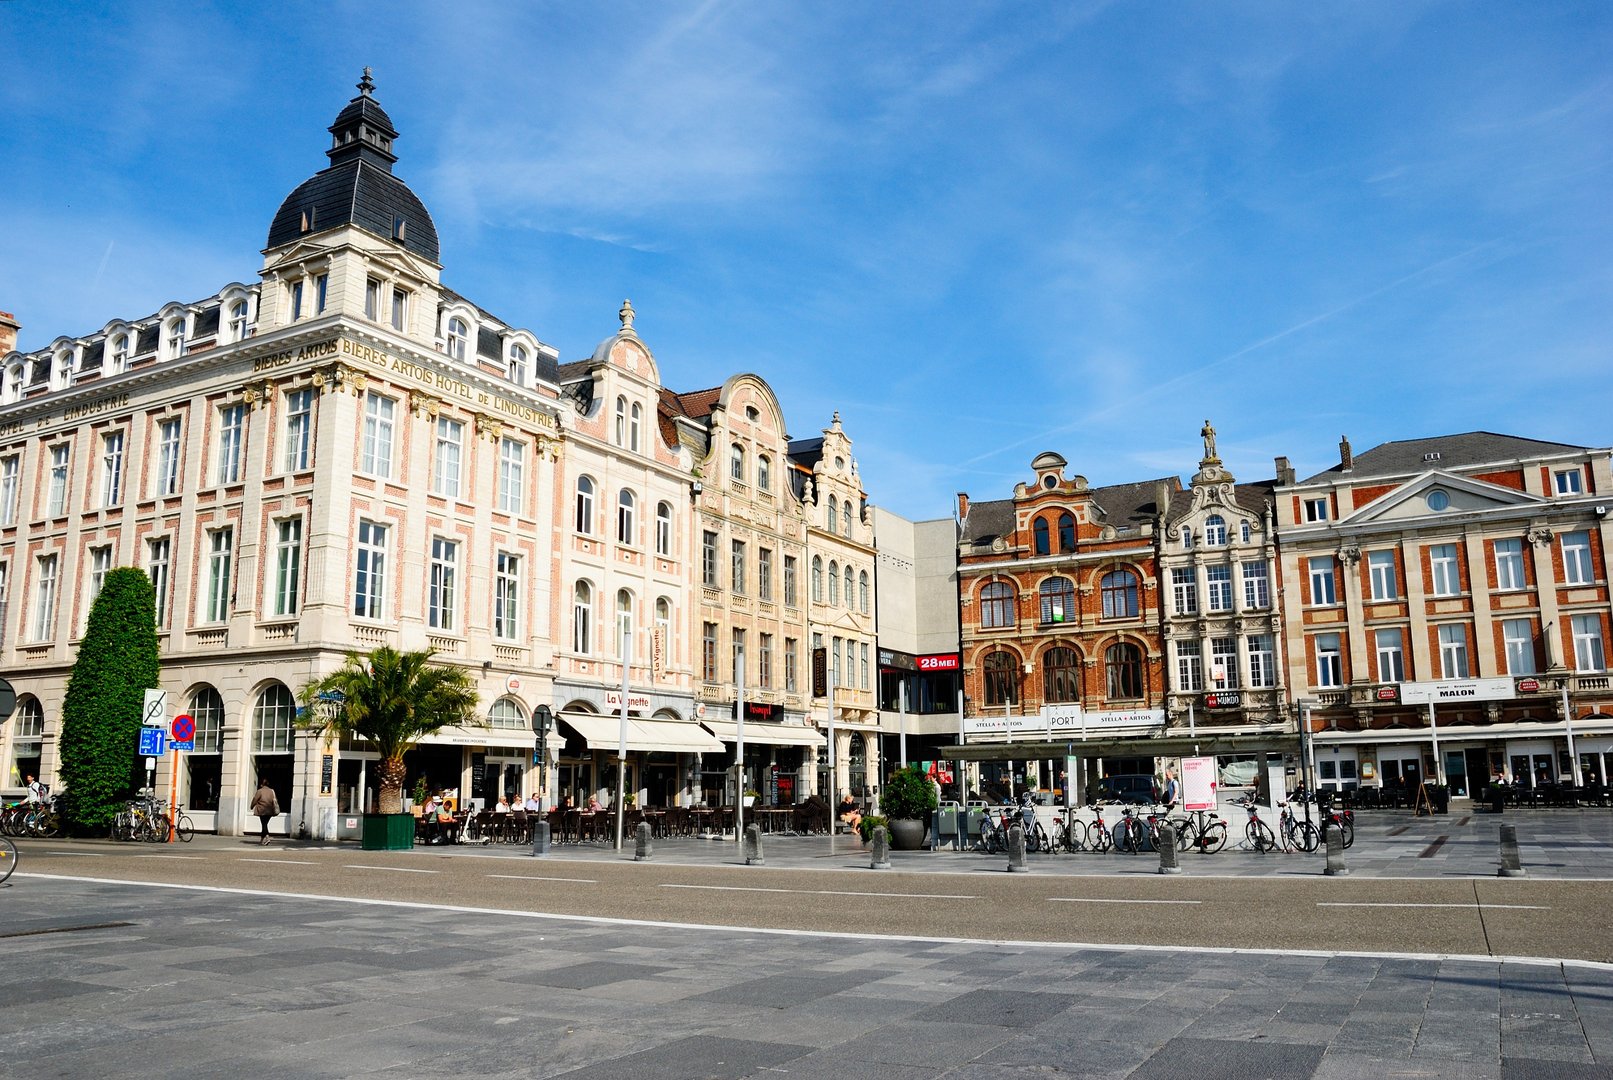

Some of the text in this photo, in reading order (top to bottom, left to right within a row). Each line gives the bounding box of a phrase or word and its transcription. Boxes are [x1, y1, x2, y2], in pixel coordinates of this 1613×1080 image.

[253, 339, 338, 373] BIERES ARTOIS
[342, 339, 554, 429] BIERES ARTOIS HOTEL DE L'INDUSTRIE
[0, 420, 25, 437] OTEL
[63, 393, 130, 421] L'INDUSTRIE
[653, 629, 661, 672] La Vignette
[921, 657, 956, 669] 28 MEI
[607, 693, 649, 708] La Vgnette
[1217, 695, 1240, 705] MUNDO
[1439, 689, 1475, 698] MALON
[1050, 716, 1075, 726] PORT
